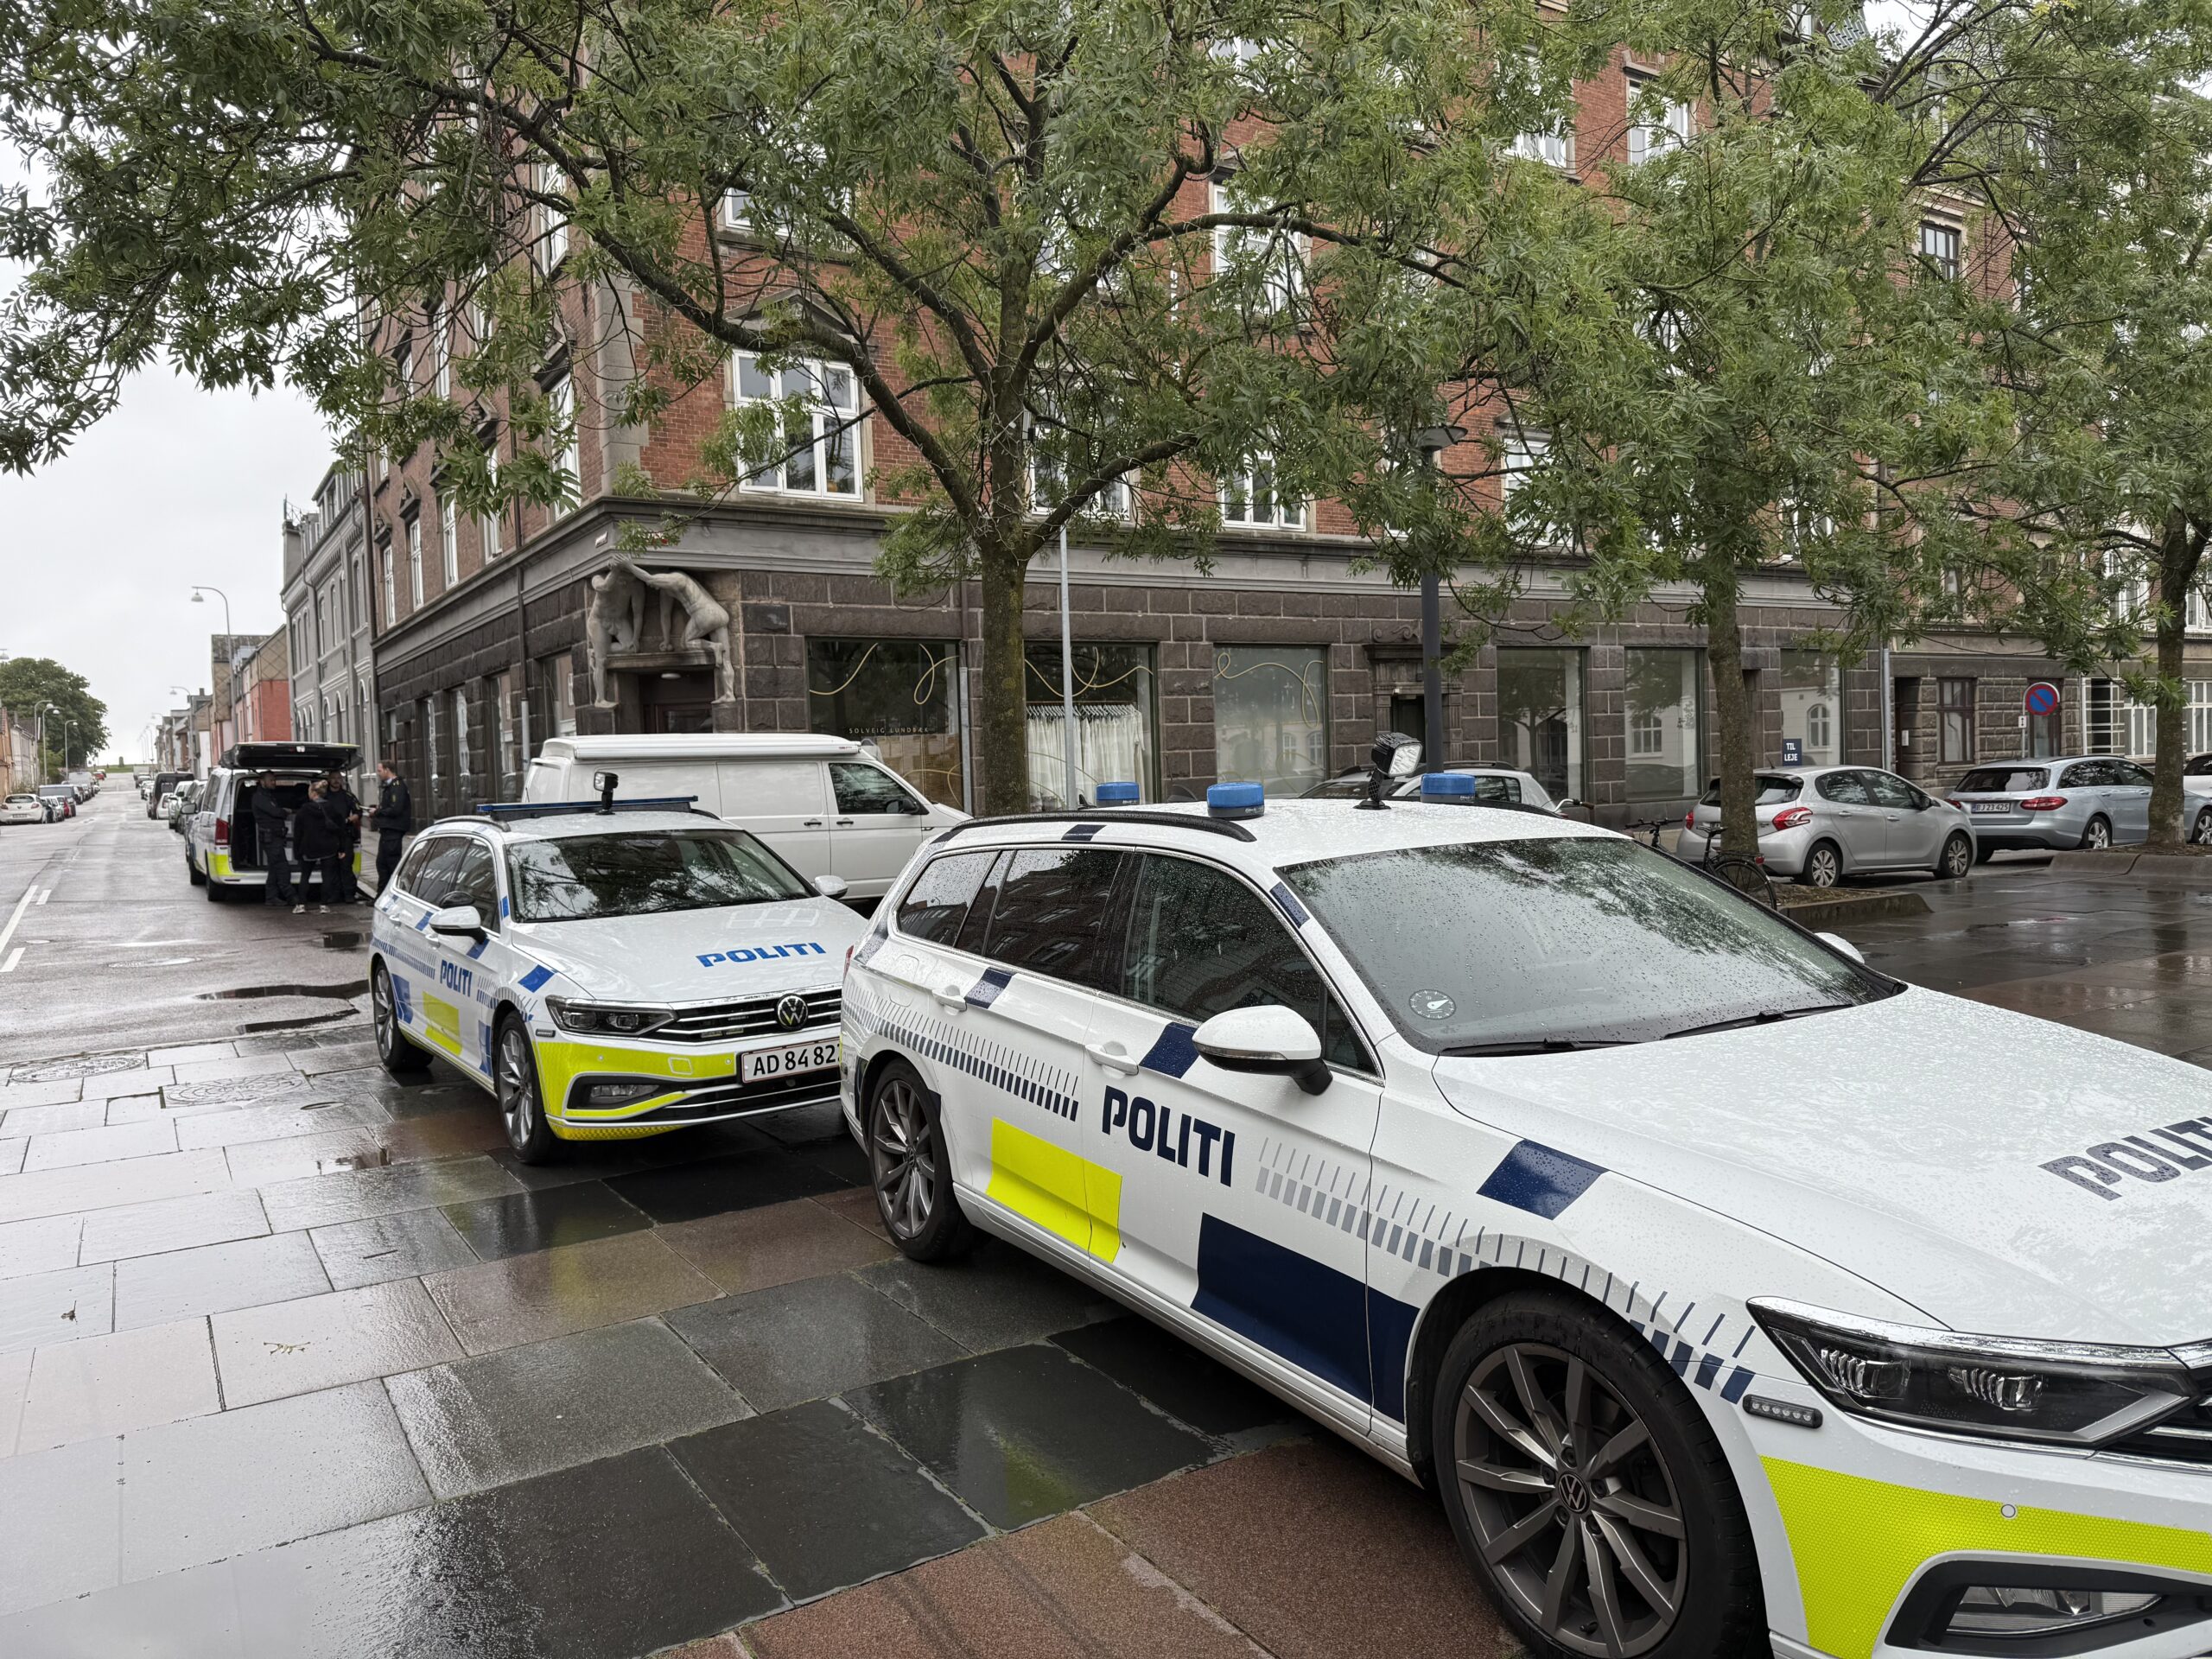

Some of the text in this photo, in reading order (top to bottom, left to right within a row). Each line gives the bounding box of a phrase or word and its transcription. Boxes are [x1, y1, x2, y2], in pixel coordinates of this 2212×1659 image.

[1784, 753, 1798, 761] LEJE
[1786, 742, 1796, 751] TIL
[696, 942, 827, 968] POLITI
[440, 959, 473, 998] POLITI
[753, 1054, 780, 1077] AD
[785, 1048, 809, 1071] 84
[1102, 1084, 1236, 1188] POLITI
[2037, 1116, 2212, 1202] POLIT
